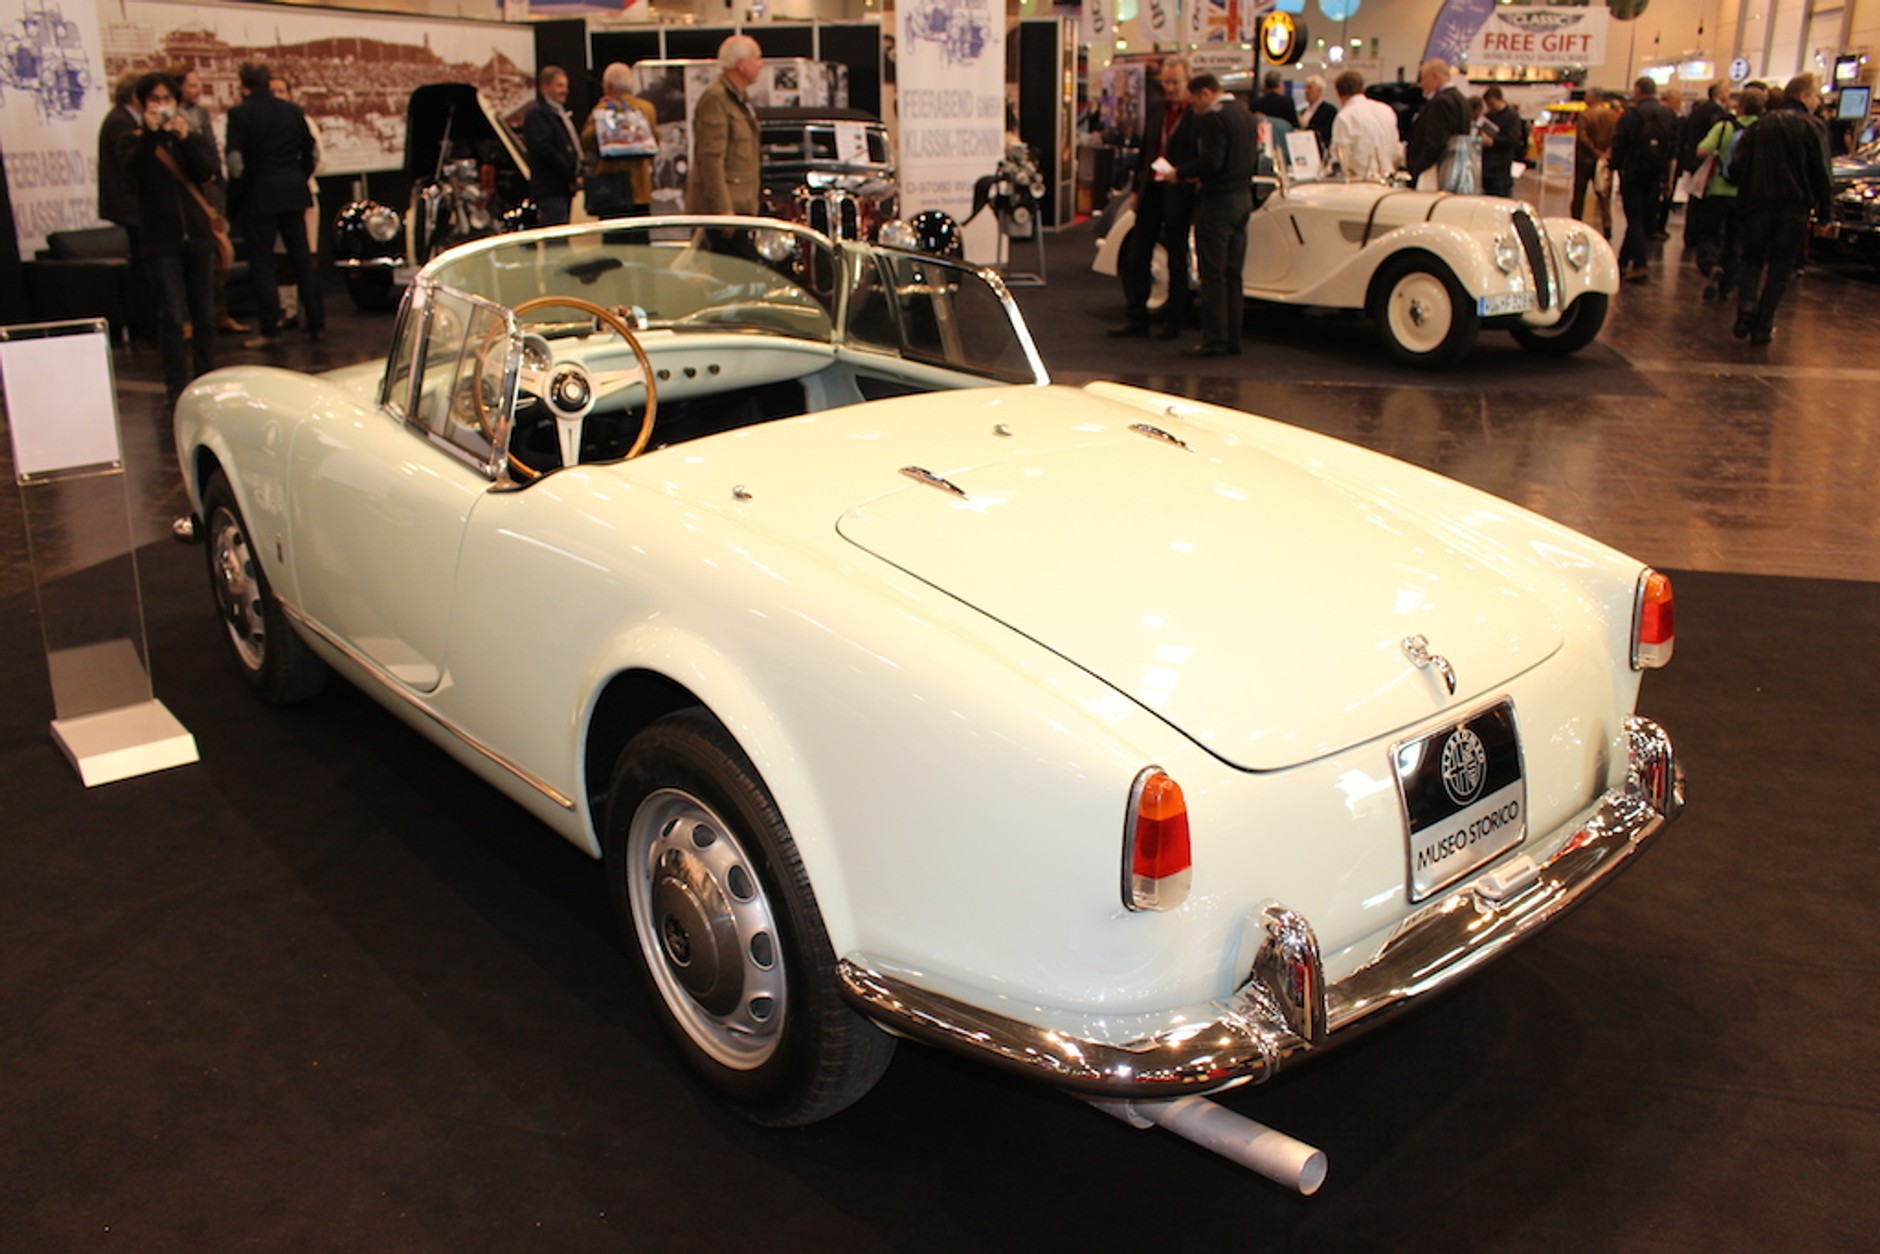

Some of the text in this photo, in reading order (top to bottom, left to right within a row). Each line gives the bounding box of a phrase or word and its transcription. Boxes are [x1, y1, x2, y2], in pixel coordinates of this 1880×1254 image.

[1483, 32, 1592, 53] FREE GIFT
[1417, 800, 1520, 871] MUSEO STORICO
